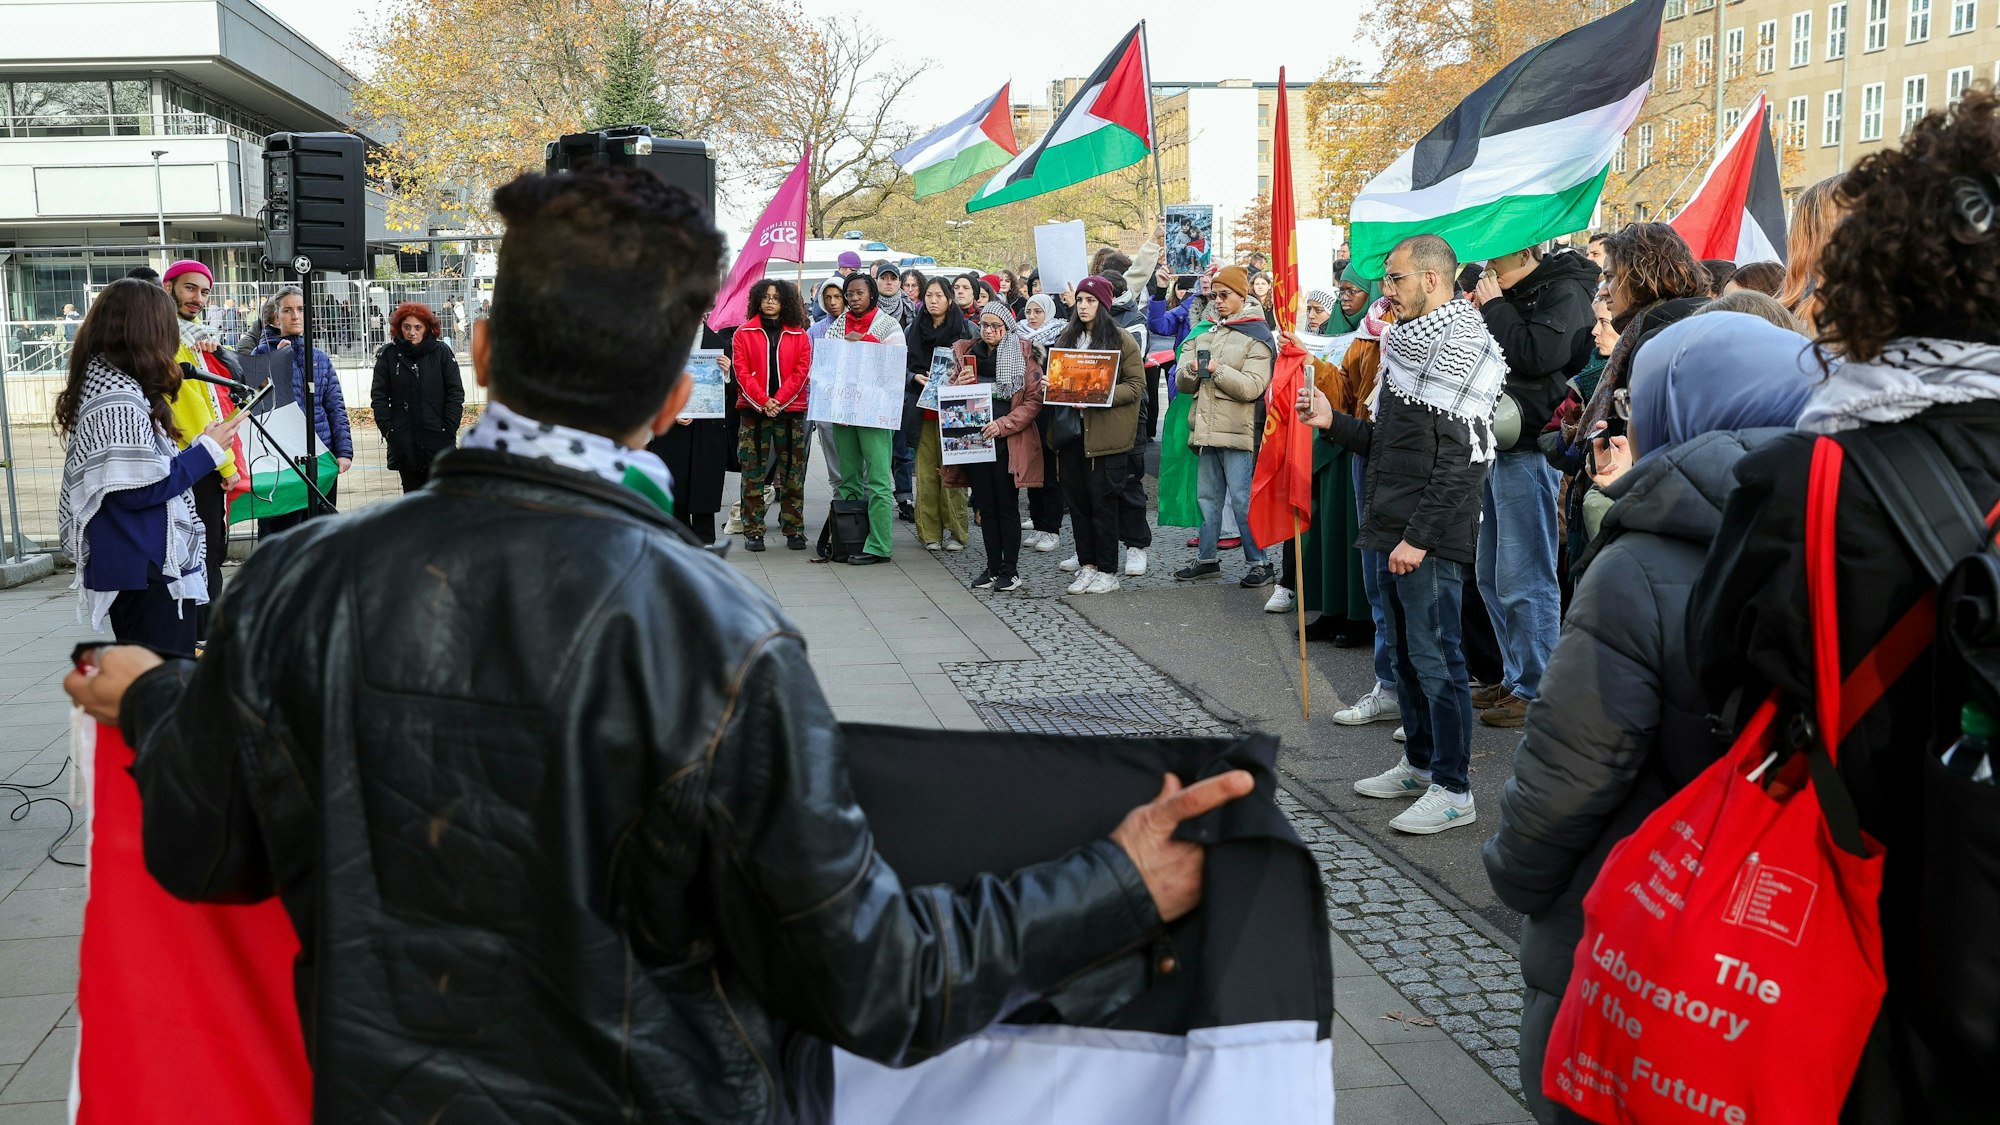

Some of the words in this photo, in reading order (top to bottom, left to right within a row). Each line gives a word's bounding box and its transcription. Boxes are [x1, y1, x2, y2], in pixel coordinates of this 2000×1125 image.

[1581, 978, 1601, 1006] of
[1602, 993, 1642, 1039] the
[1592, 932, 1750, 1041] Laboratory
[1714, 953, 1781, 1004] The
[1631, 1056, 1746, 1125] Future
